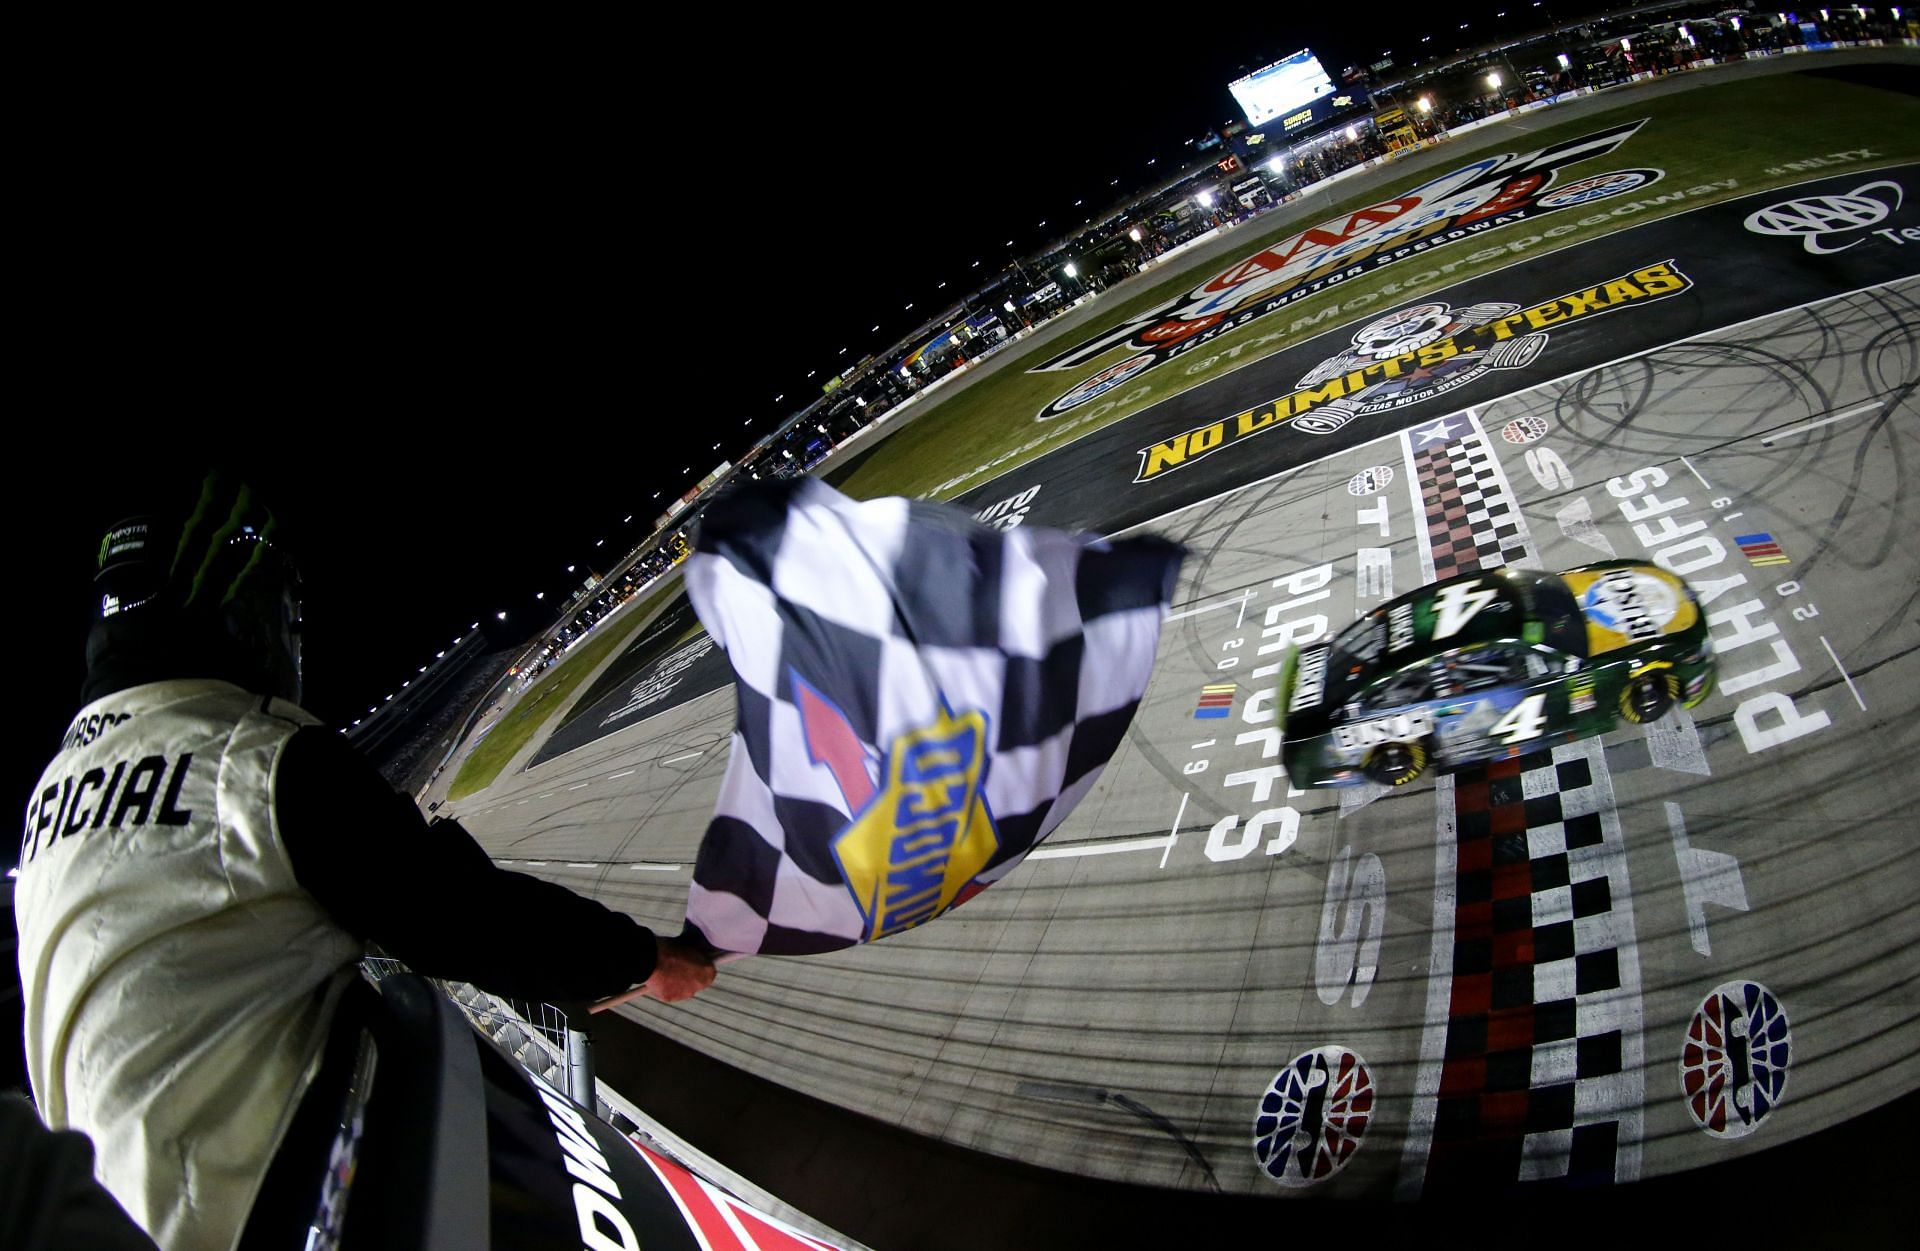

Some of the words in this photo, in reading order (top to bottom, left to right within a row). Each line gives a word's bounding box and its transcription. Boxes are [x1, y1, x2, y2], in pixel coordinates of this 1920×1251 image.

[1283, 109, 1312, 127] SUNOCO
[1168, 312, 1254, 358] TEXAS
[1266, 266, 1364, 311] MOTOR
[1377, 210, 1528, 266] SPEEDWAY
[1203, 195, 1424, 293] AAA
[1142, 421, 1223, 480] NO
[1474, 263, 1687, 342] TEXAS
[1359, 398, 1393, 414] TEXAS
[1395, 388, 1435, 407] MOTOR
[1437, 364, 1489, 393] SPEEDWAY
[1431, 578, 1499, 642] 4
[1488, 692, 1548, 746] 4
[879, 727, 980, 938] UNOCO
